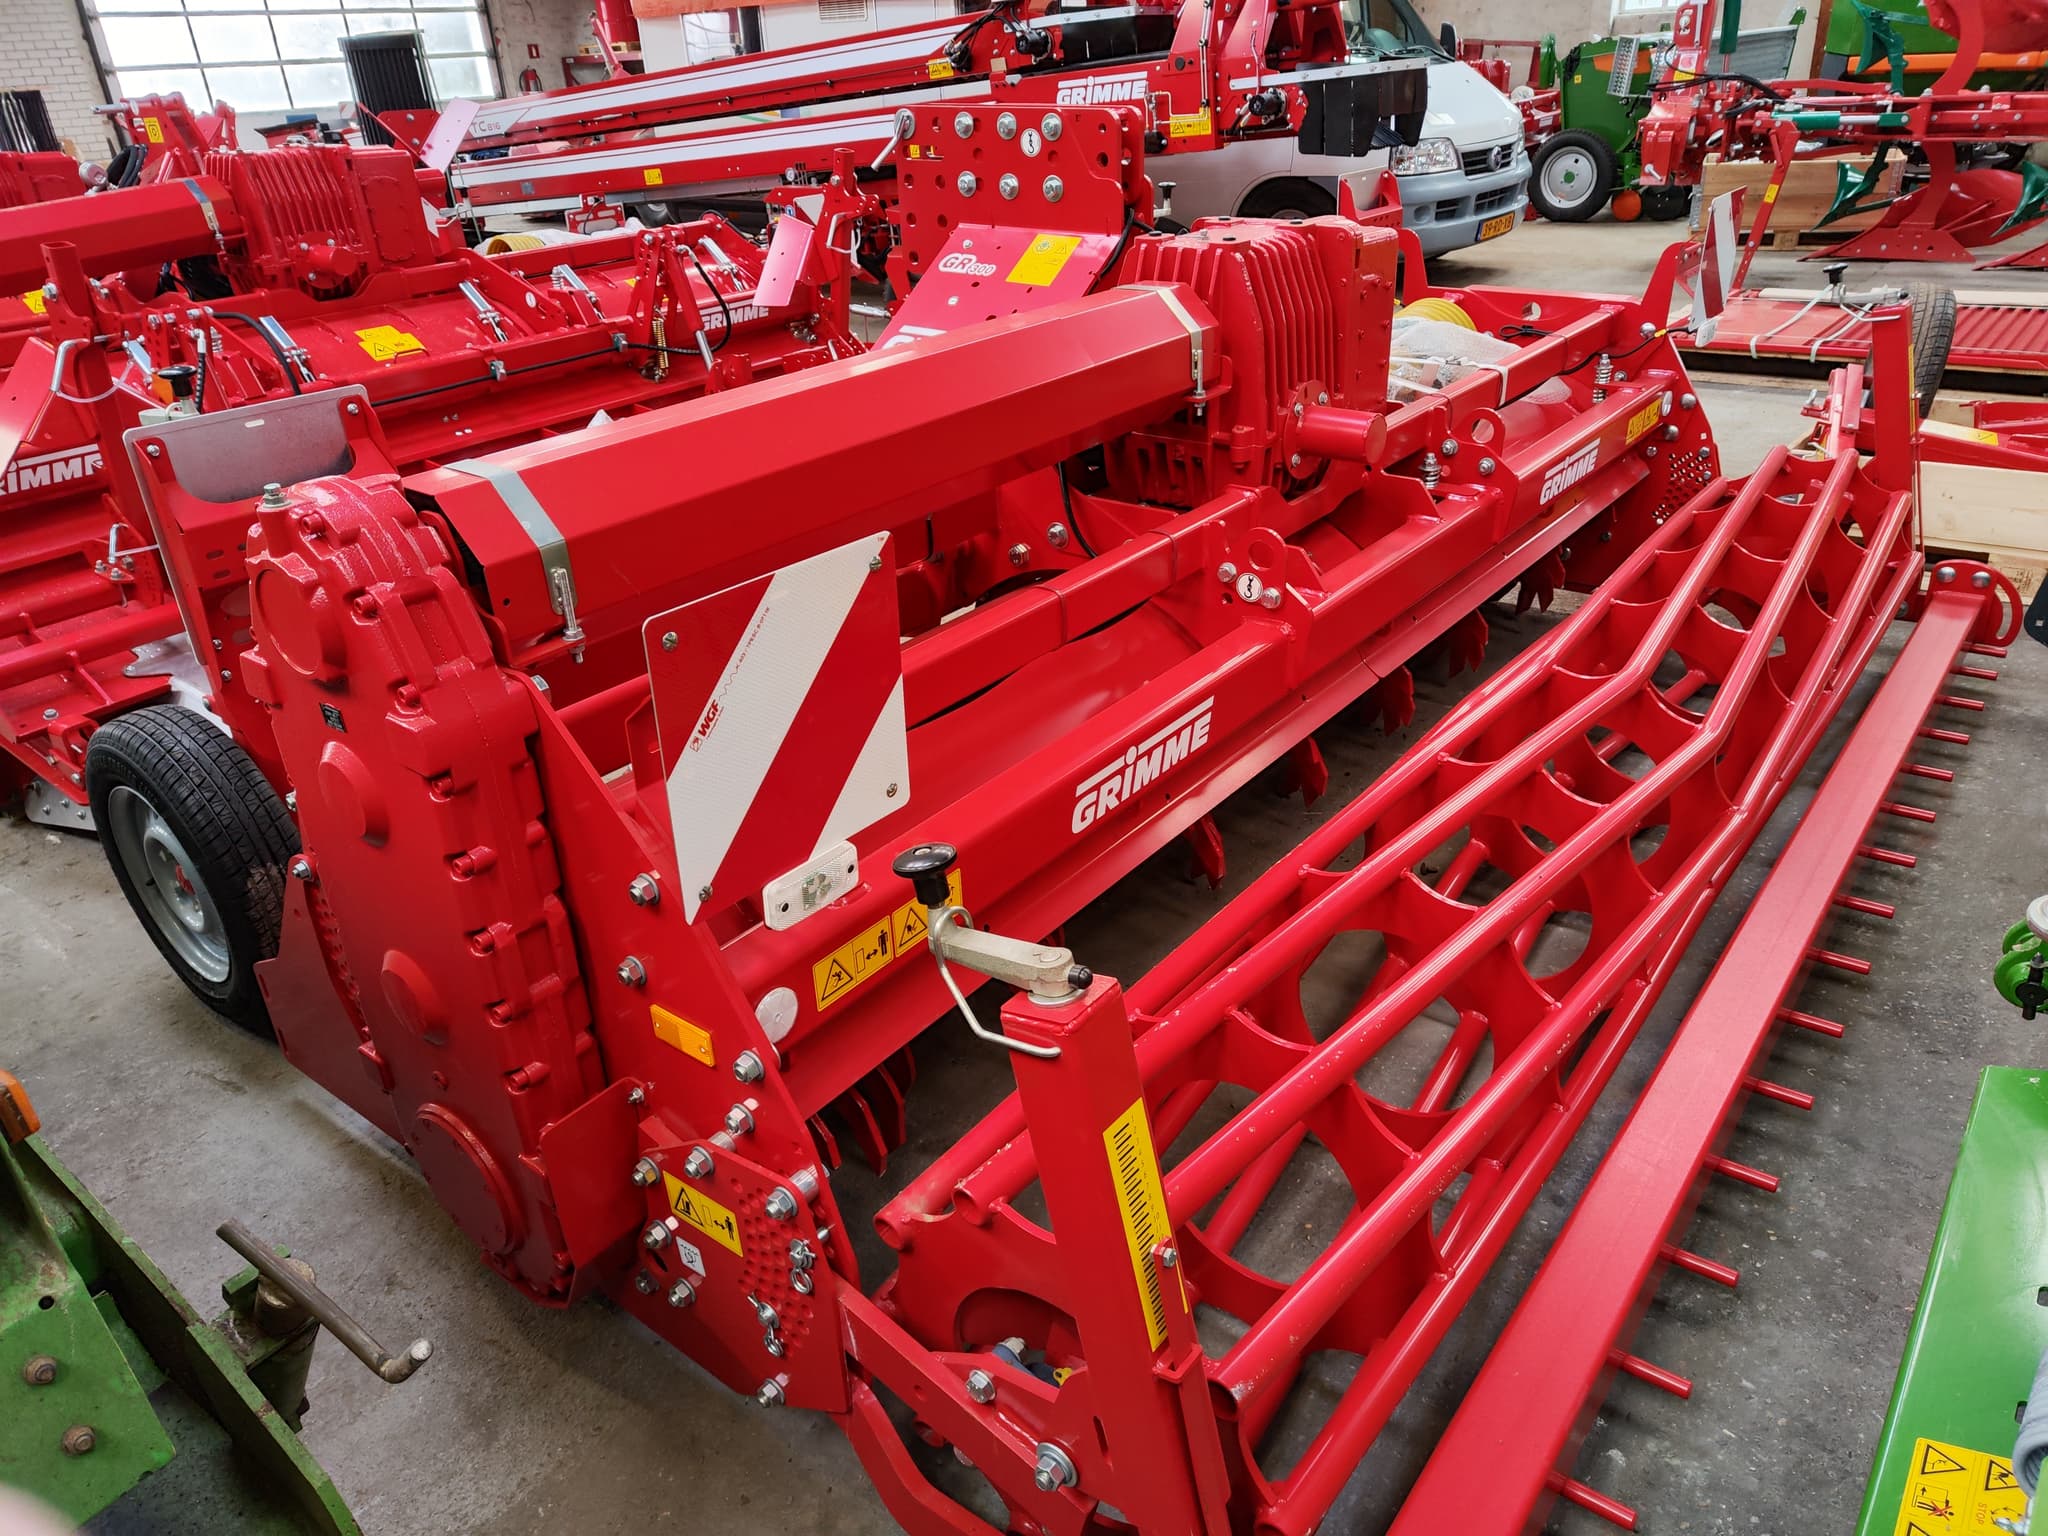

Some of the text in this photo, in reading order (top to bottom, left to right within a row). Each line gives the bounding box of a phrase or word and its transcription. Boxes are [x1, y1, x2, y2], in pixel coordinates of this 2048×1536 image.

[1056, 76, 1148, 106] GRIMME
[1540, 445, 1599, 505] GRIMME
[698, 700, 719, 738] WGF
[1071, 708, 1213, 834] GRIMME
[1975, 1503, 1988, 1525] STOP
